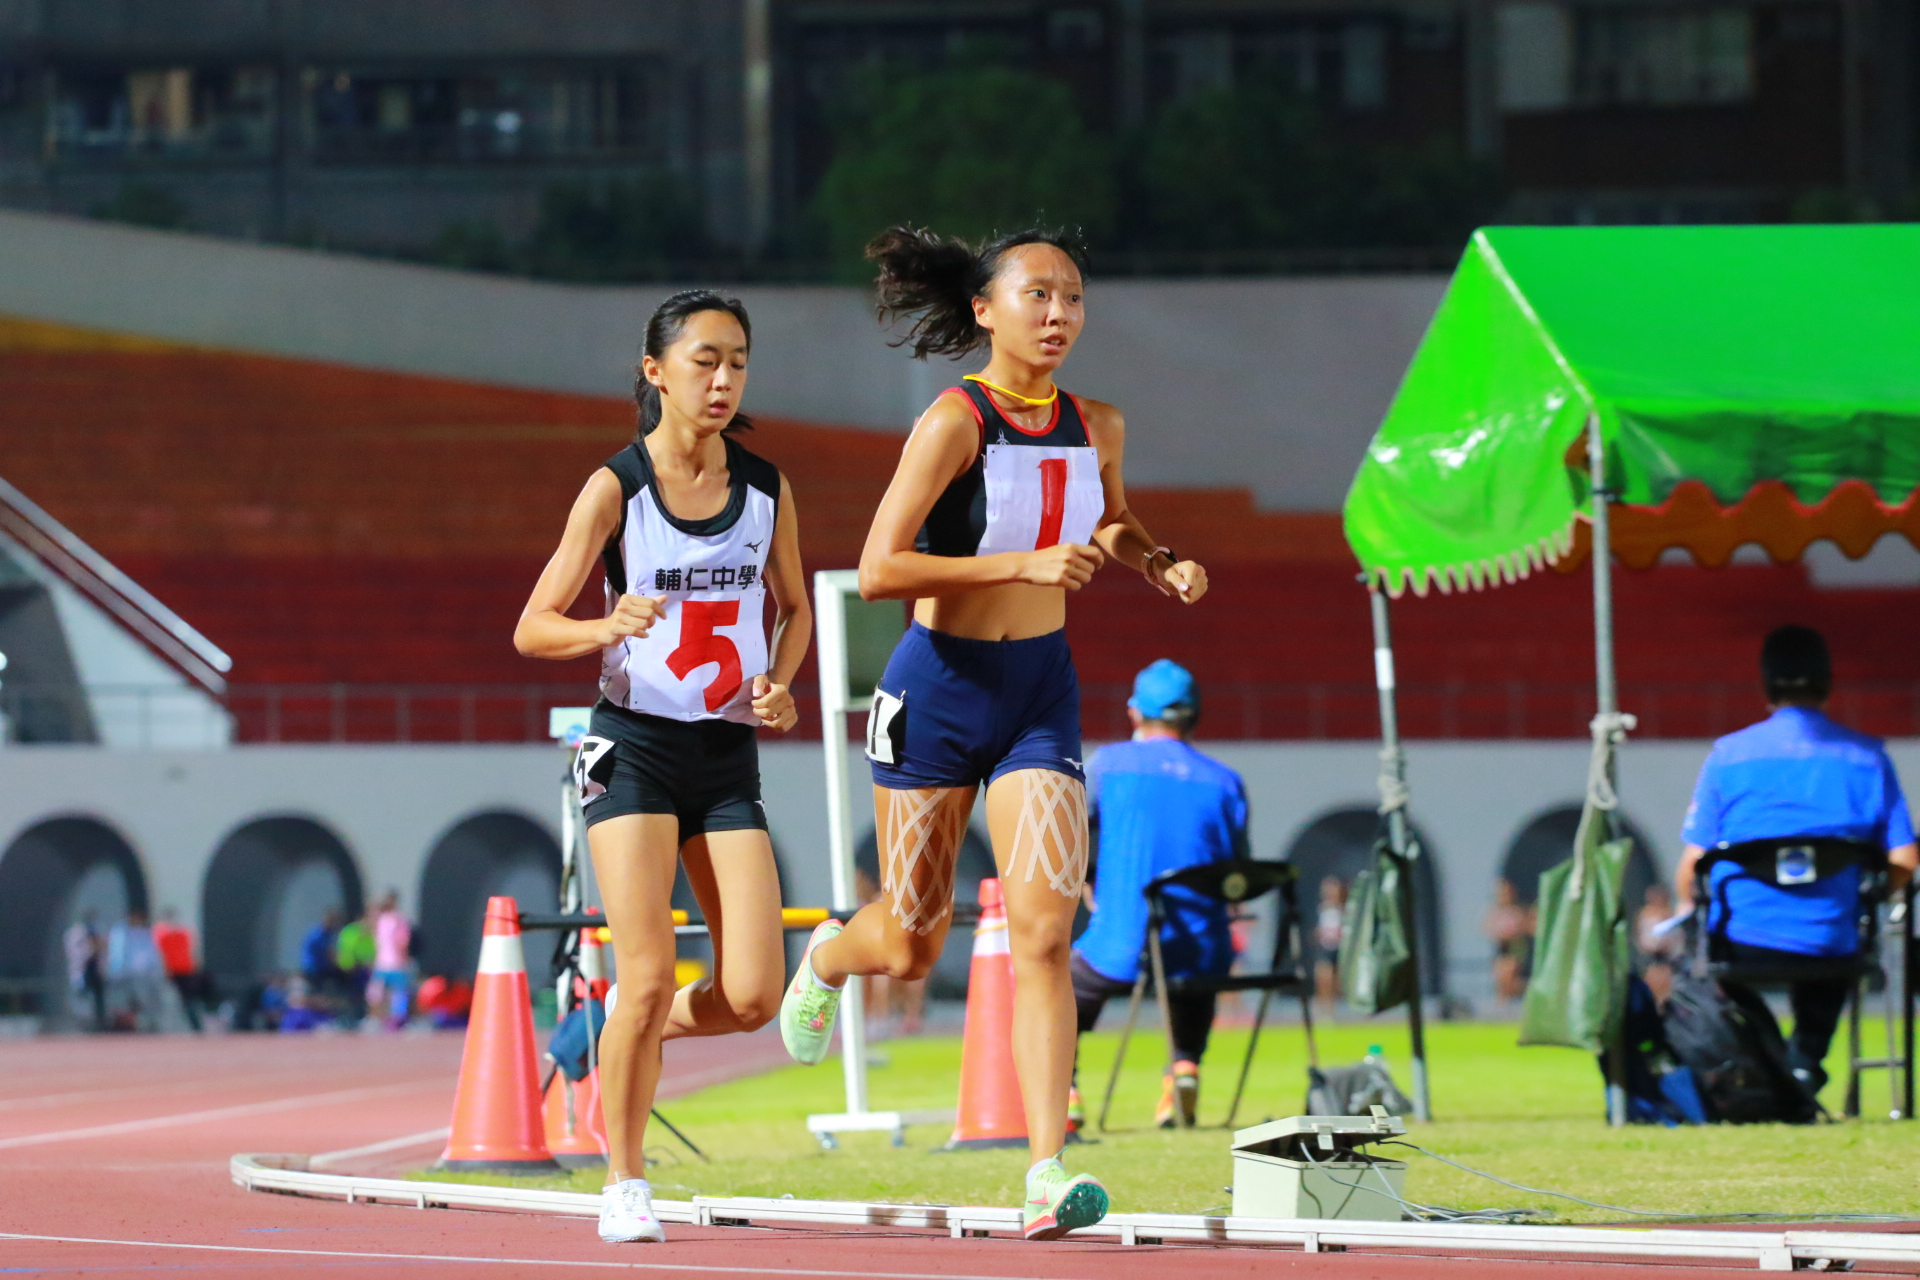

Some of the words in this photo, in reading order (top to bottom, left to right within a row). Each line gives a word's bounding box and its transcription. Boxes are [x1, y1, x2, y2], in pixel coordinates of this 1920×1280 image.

[1034, 458, 1068, 551] 1
[655, 564, 758, 592] 輔仁中學
[665, 599, 743, 712] 5
[870, 695, 884, 755] 1
[576, 741, 600, 800] 5
